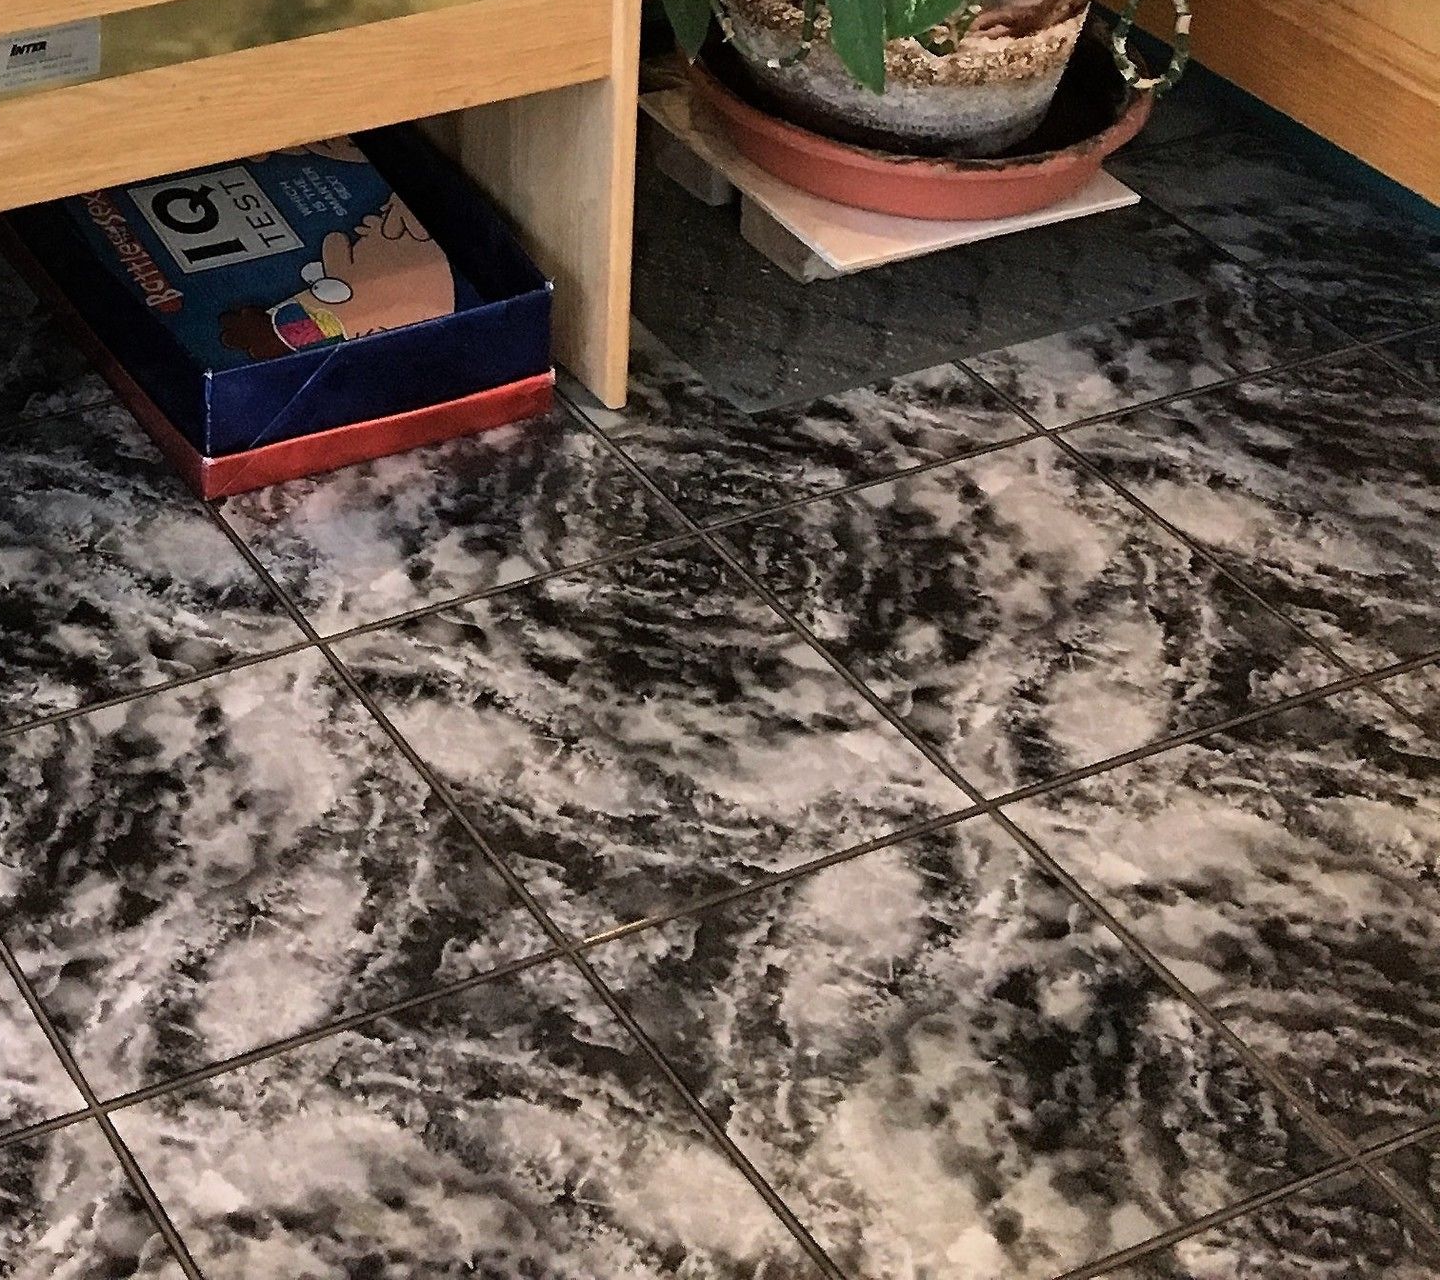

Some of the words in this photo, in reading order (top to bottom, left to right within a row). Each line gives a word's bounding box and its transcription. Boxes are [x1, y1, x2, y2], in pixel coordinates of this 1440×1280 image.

[9, 40, 48, 57] INTER
[150, 182, 250, 267] IQ
[221, 179, 287, 249] TEST
